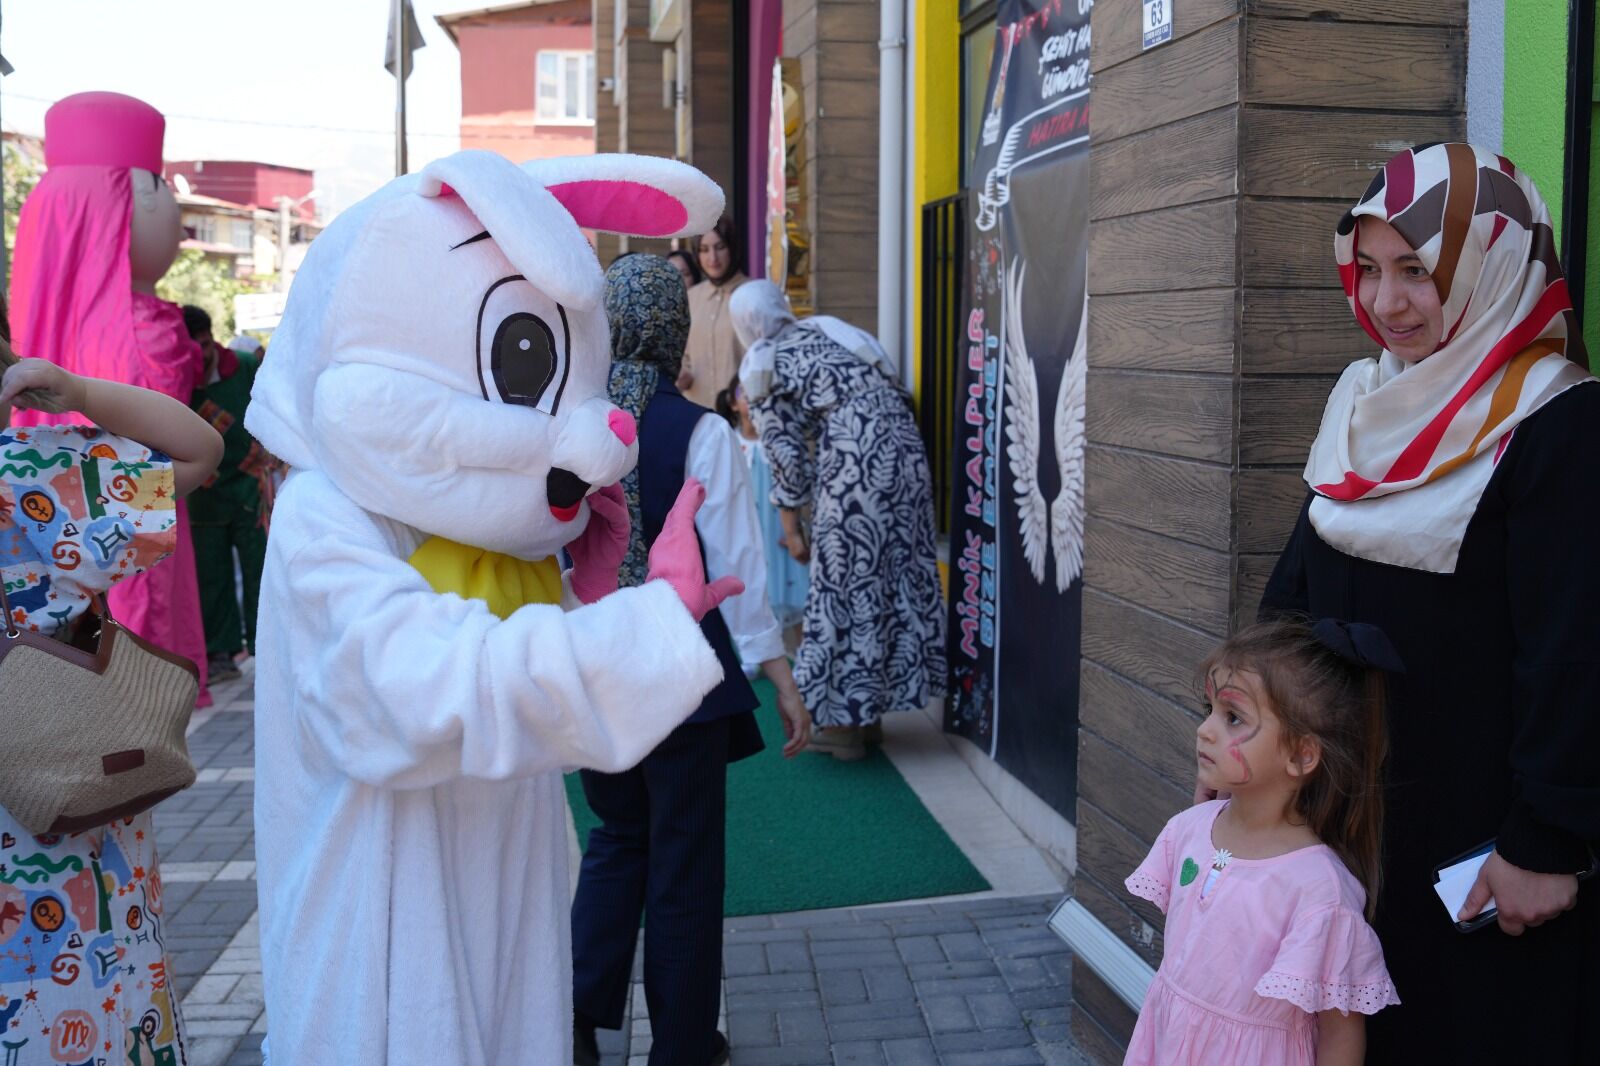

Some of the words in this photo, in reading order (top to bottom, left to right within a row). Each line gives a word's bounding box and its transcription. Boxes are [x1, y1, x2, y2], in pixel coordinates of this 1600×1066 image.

[1151, 1, 1163, 27] 63
[1042, 58, 1090, 99] GÜNDÜZ
[964, 307, 985, 518] KALPLER
[981, 328, 999, 527] EMANET
